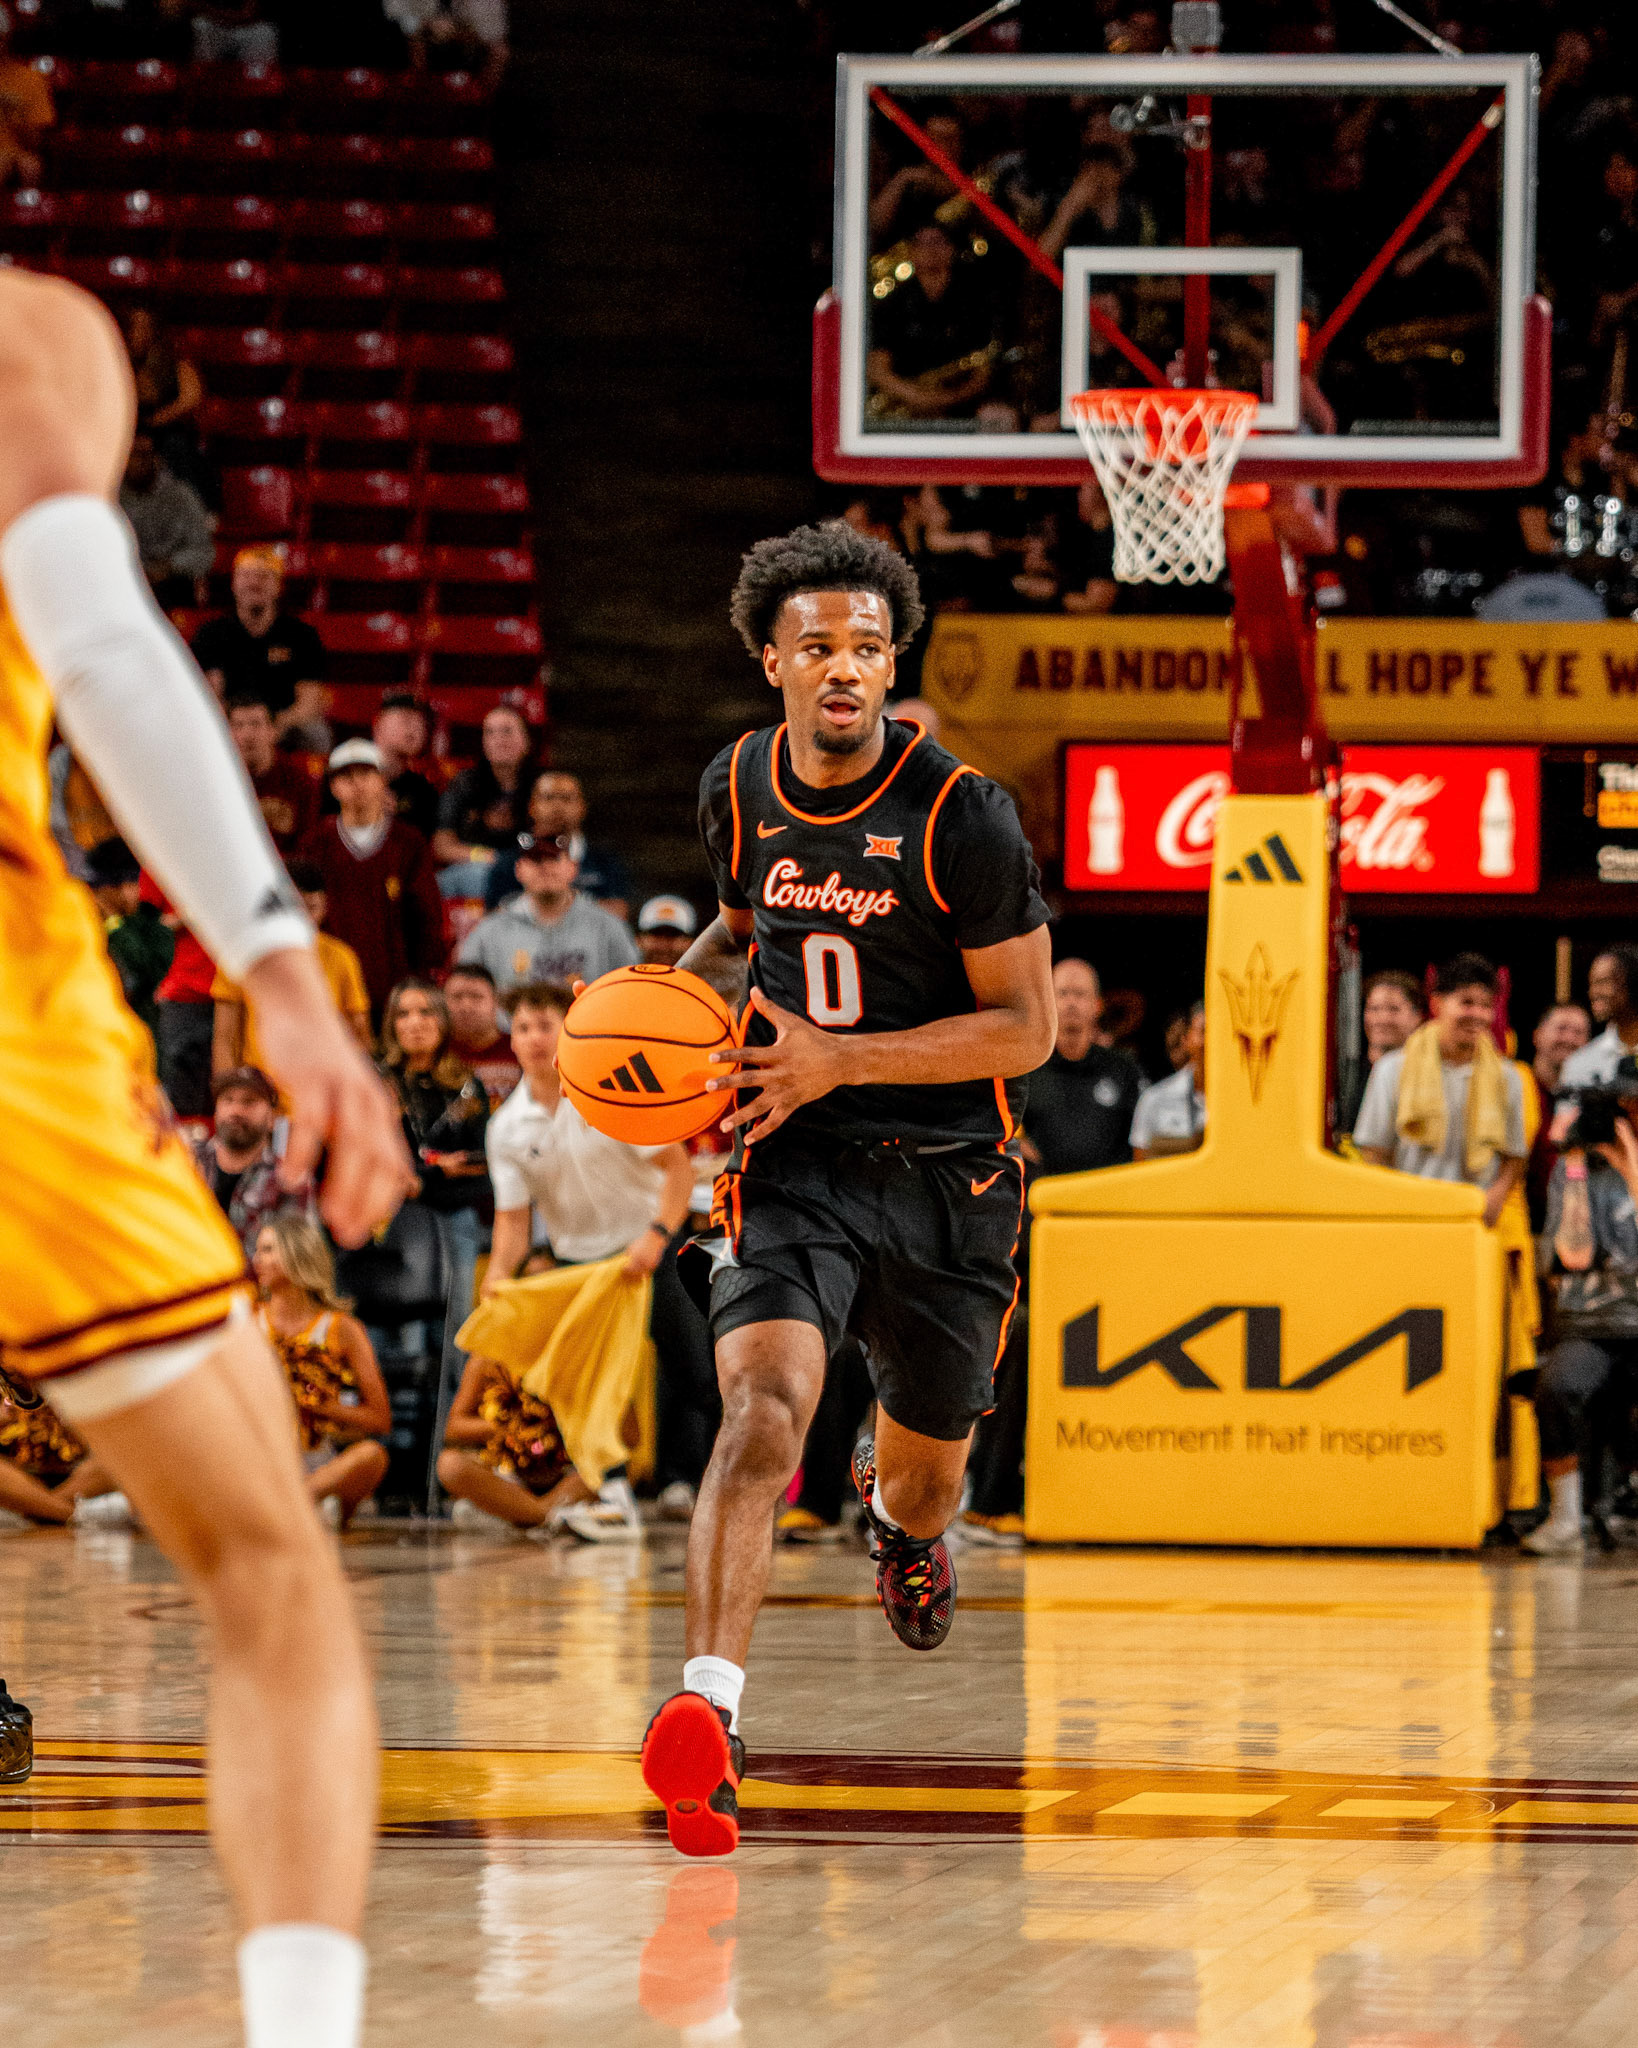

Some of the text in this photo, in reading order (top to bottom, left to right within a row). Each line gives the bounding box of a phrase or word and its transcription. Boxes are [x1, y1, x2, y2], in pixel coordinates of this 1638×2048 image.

[1366, 650, 1493, 697] HOPE
[1520, 650, 1578, 698] YE
[763, 858, 899, 926] Cowboys
[801, 932, 863, 1027] 0
[1061, 1302, 1445, 1395] KIA
[1055, 1418, 1446, 1463] Movement that inspires
